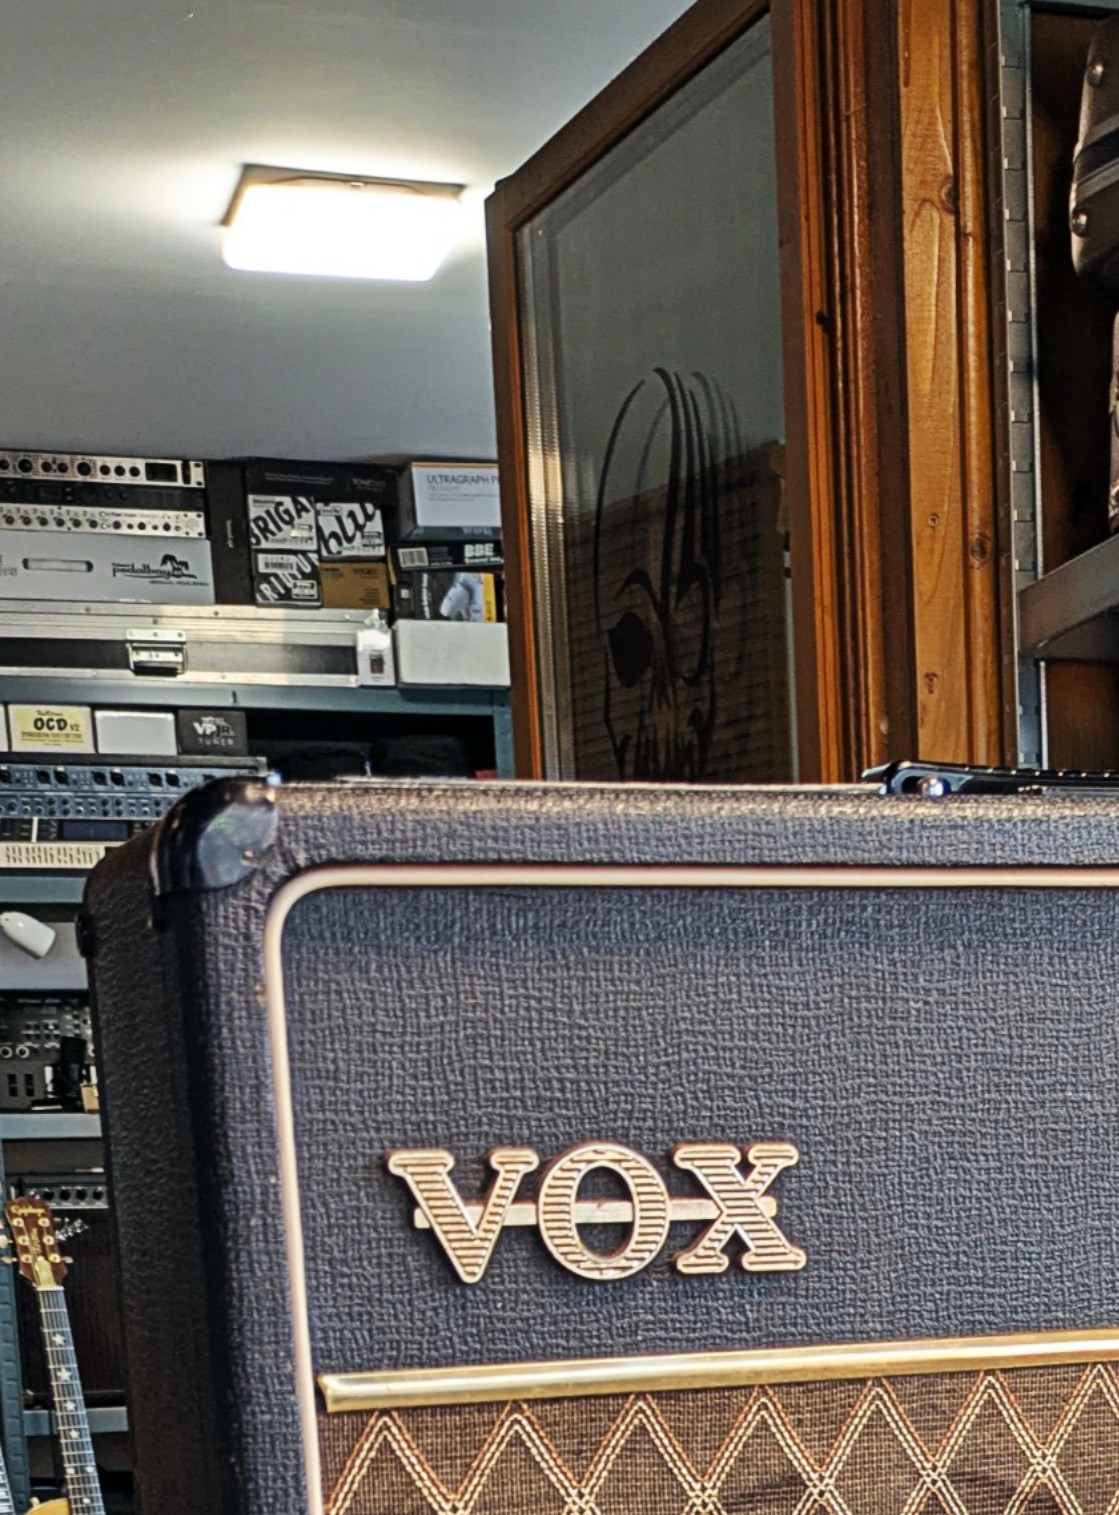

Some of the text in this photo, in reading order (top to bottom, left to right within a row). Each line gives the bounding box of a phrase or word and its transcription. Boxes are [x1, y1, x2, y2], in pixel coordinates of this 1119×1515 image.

[426, 474, 489, 485] ULTRAGRAPH
[464, 543, 494, 557] BBE
[33, 717, 68, 731] OCD
[387, 1141, 808, 1284] VOX
